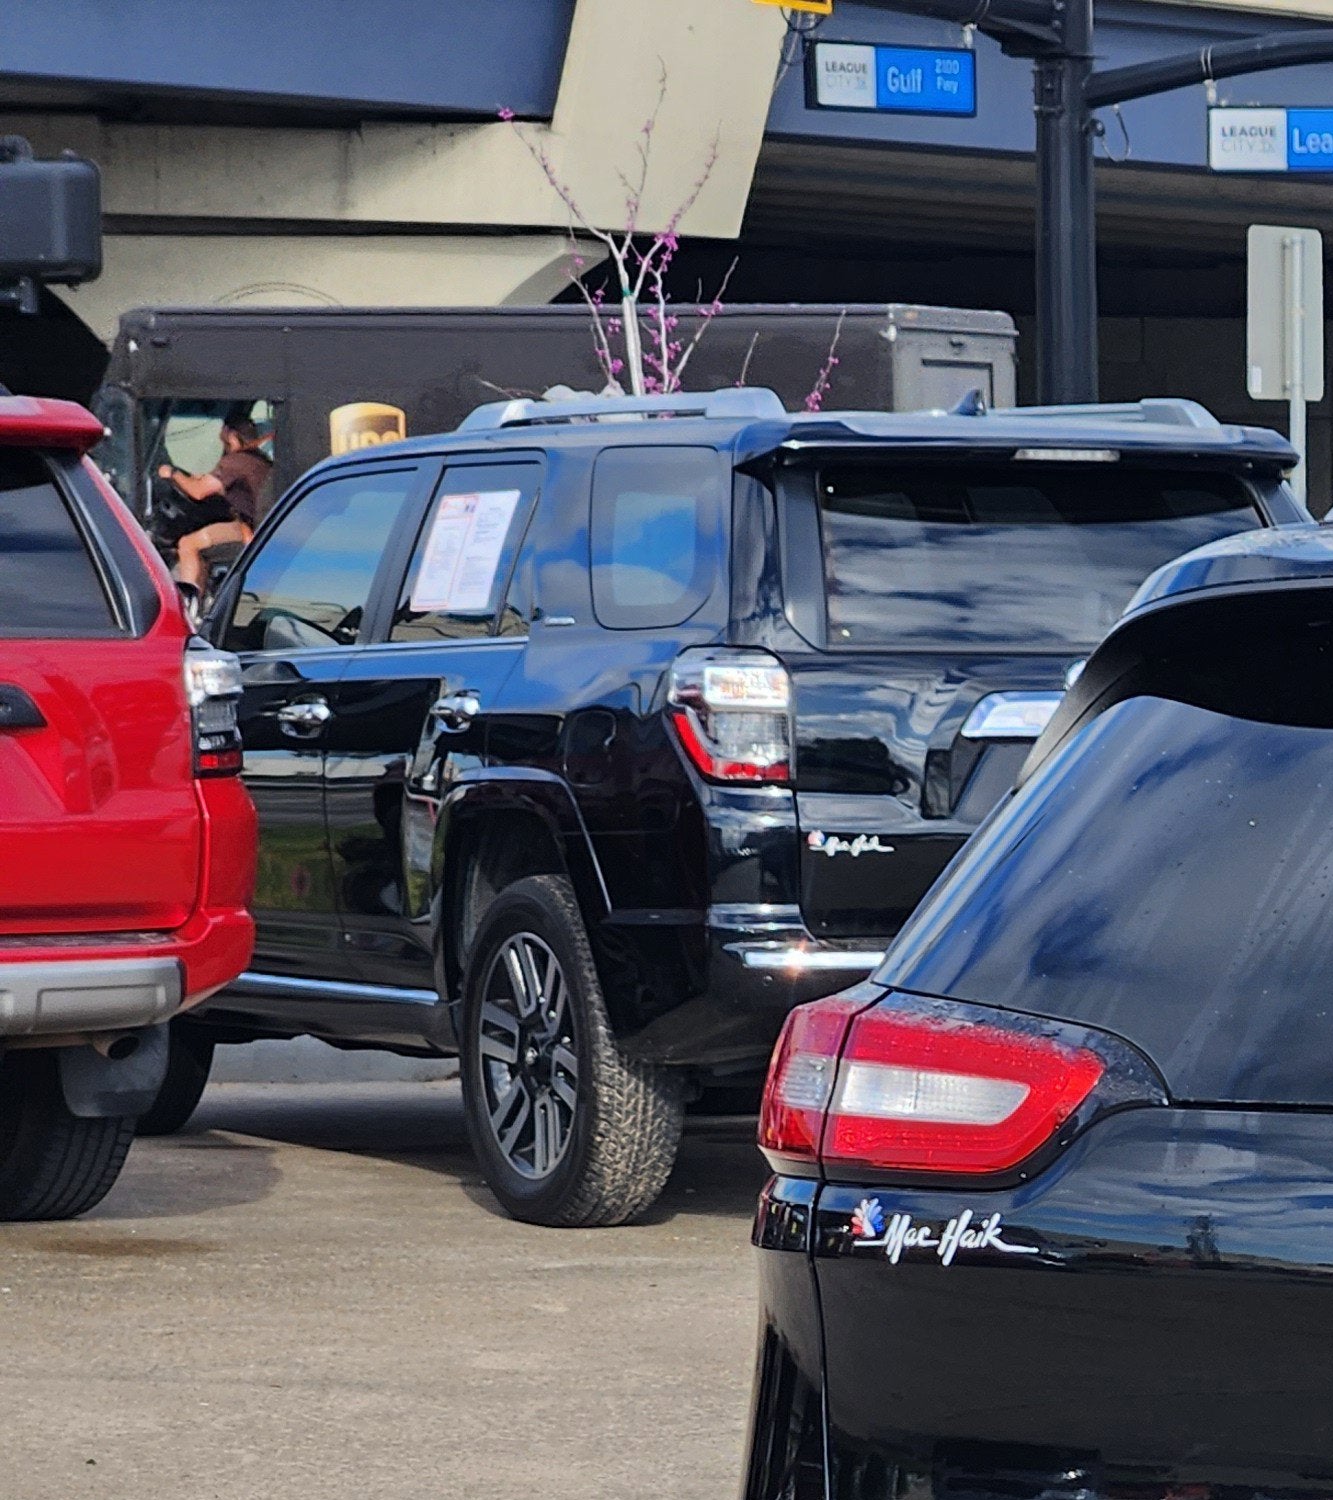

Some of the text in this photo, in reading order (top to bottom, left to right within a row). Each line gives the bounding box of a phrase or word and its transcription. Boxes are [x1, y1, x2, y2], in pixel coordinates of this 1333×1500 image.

[825, 61, 867, 74] LEAGUE
[887, 66, 923, 93] Gulf
[1221, 126, 1277, 138] LEAGUE
[874, 1208, 1040, 1266] Mac Haik
